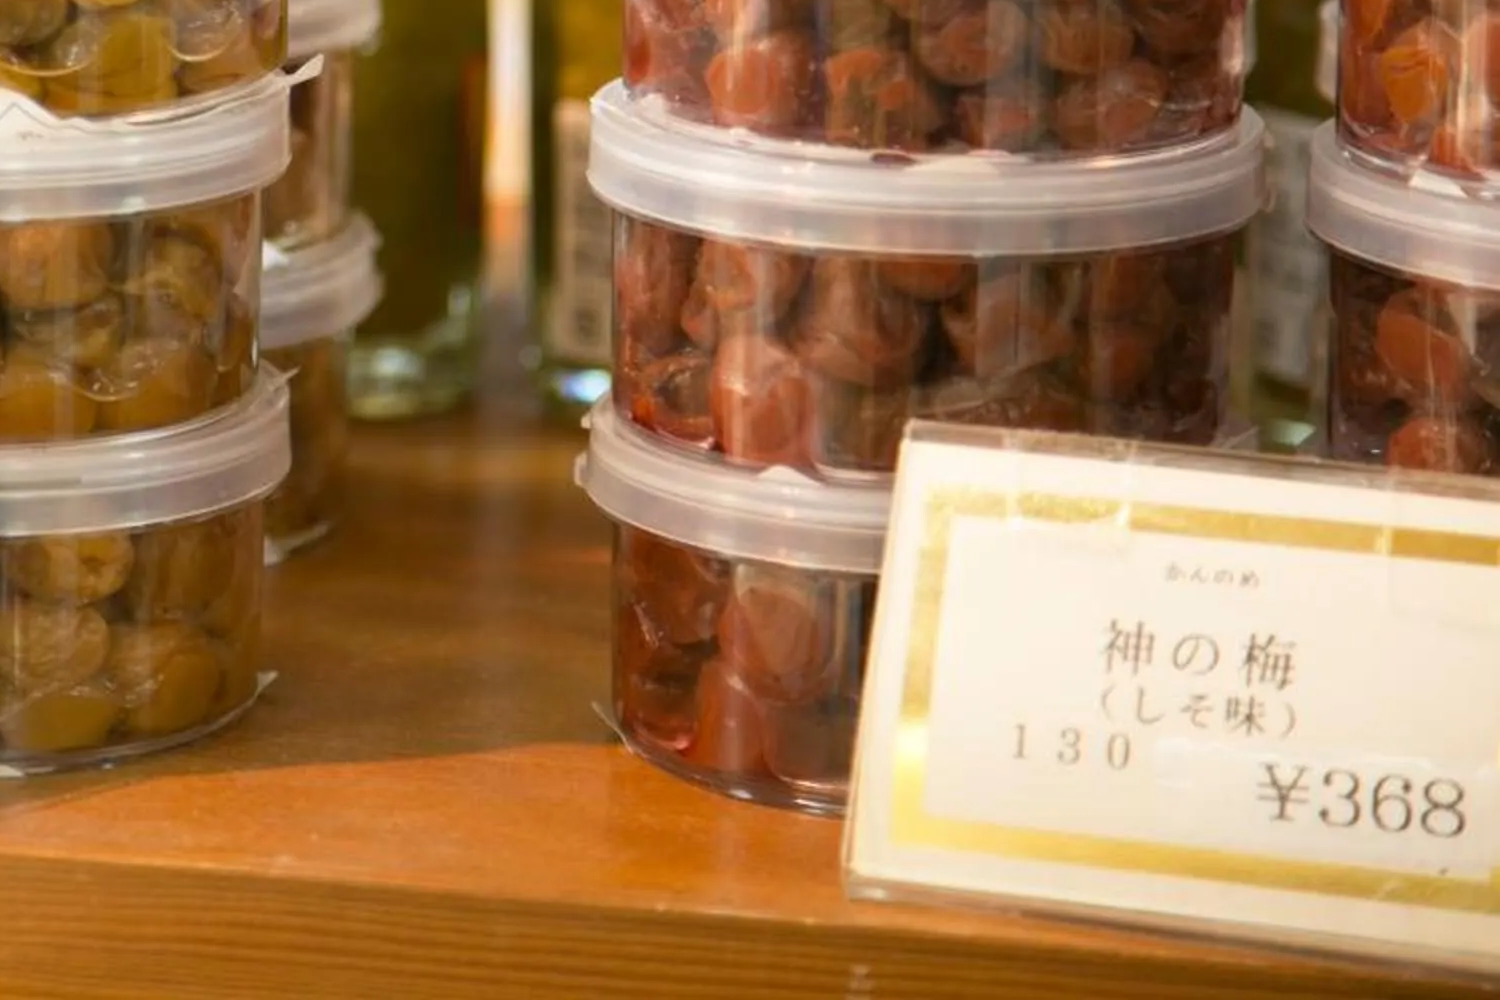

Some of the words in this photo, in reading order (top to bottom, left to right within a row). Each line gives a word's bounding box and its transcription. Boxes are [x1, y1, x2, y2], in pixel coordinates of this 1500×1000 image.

[1101, 618, 1298, 692] 神の梅
[1012, 723, 1132, 772] 130
[1257, 761, 1467, 840] ¥368
